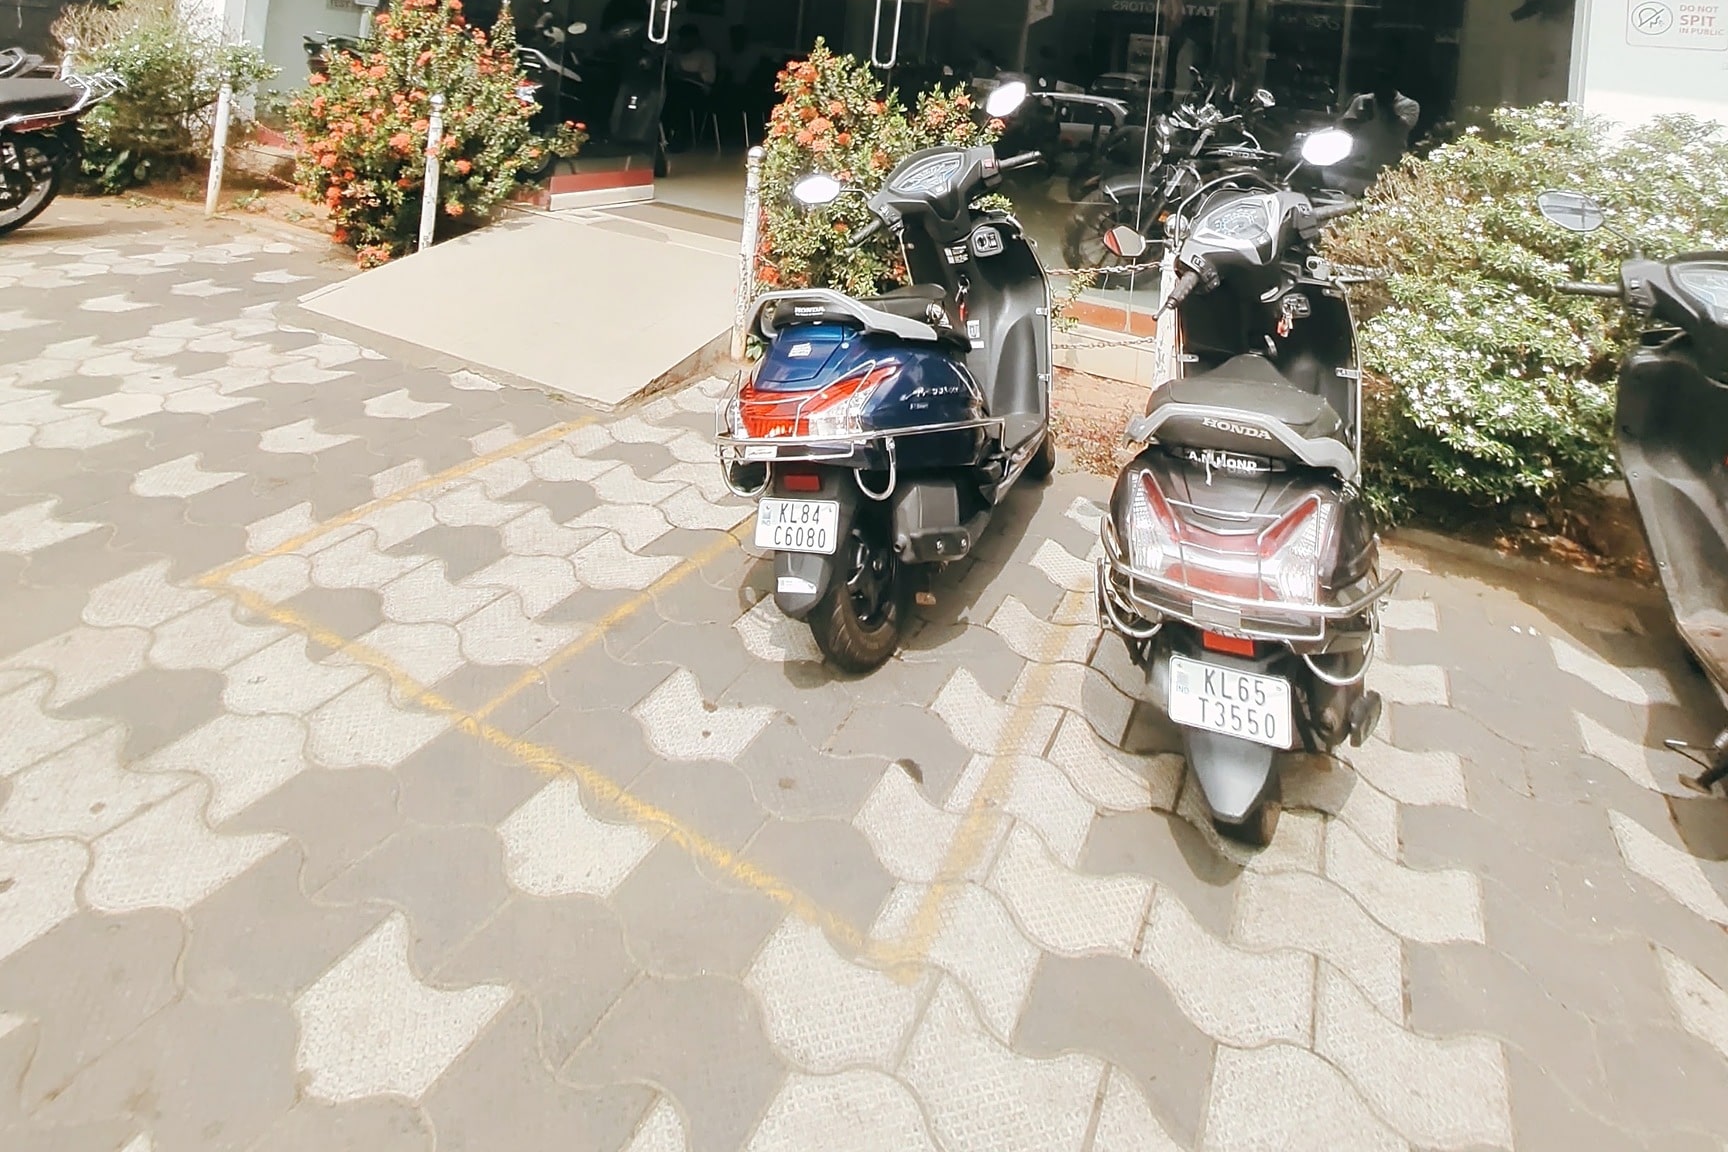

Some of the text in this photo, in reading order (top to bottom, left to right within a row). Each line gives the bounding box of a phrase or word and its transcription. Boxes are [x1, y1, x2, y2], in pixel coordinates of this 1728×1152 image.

[1679, 4, 1719, 14] DO NOT
[1679, 14, 1716, 27] SPIT
[1679, 27, 1725, 37] IN PUBLIC
[1202, 416, 1273, 440] HONDA
[779, 502, 820, 525] KL84
[774, 525, 826, 549] C6080
[1204, 667, 1266, 707] KL65
[1198, 696, 1276, 739] T3550
